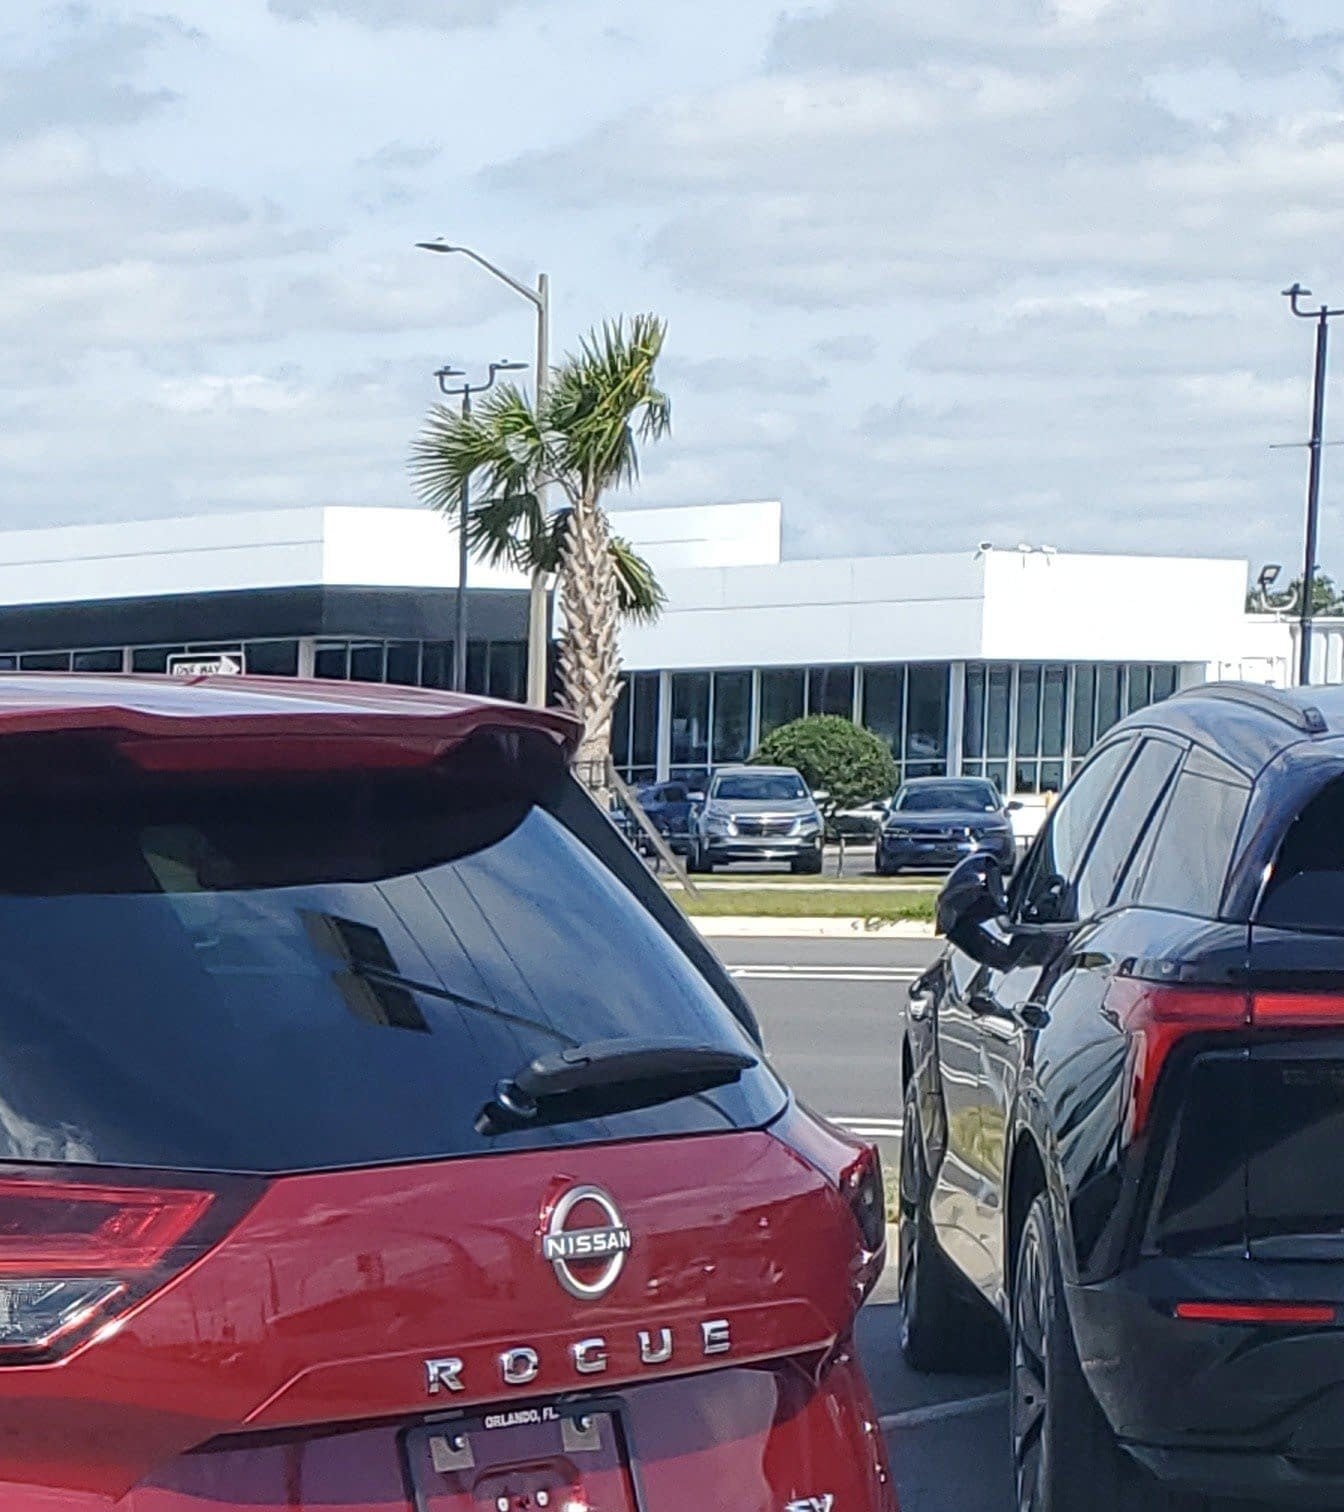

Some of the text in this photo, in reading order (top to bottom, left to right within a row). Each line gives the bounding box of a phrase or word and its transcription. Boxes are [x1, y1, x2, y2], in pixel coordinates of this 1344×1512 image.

[547, 1229, 631, 1258] NISSAN
[425, 1319, 732, 1393] ROGUE
[485, 1409, 541, 1429] ORLANDO,
